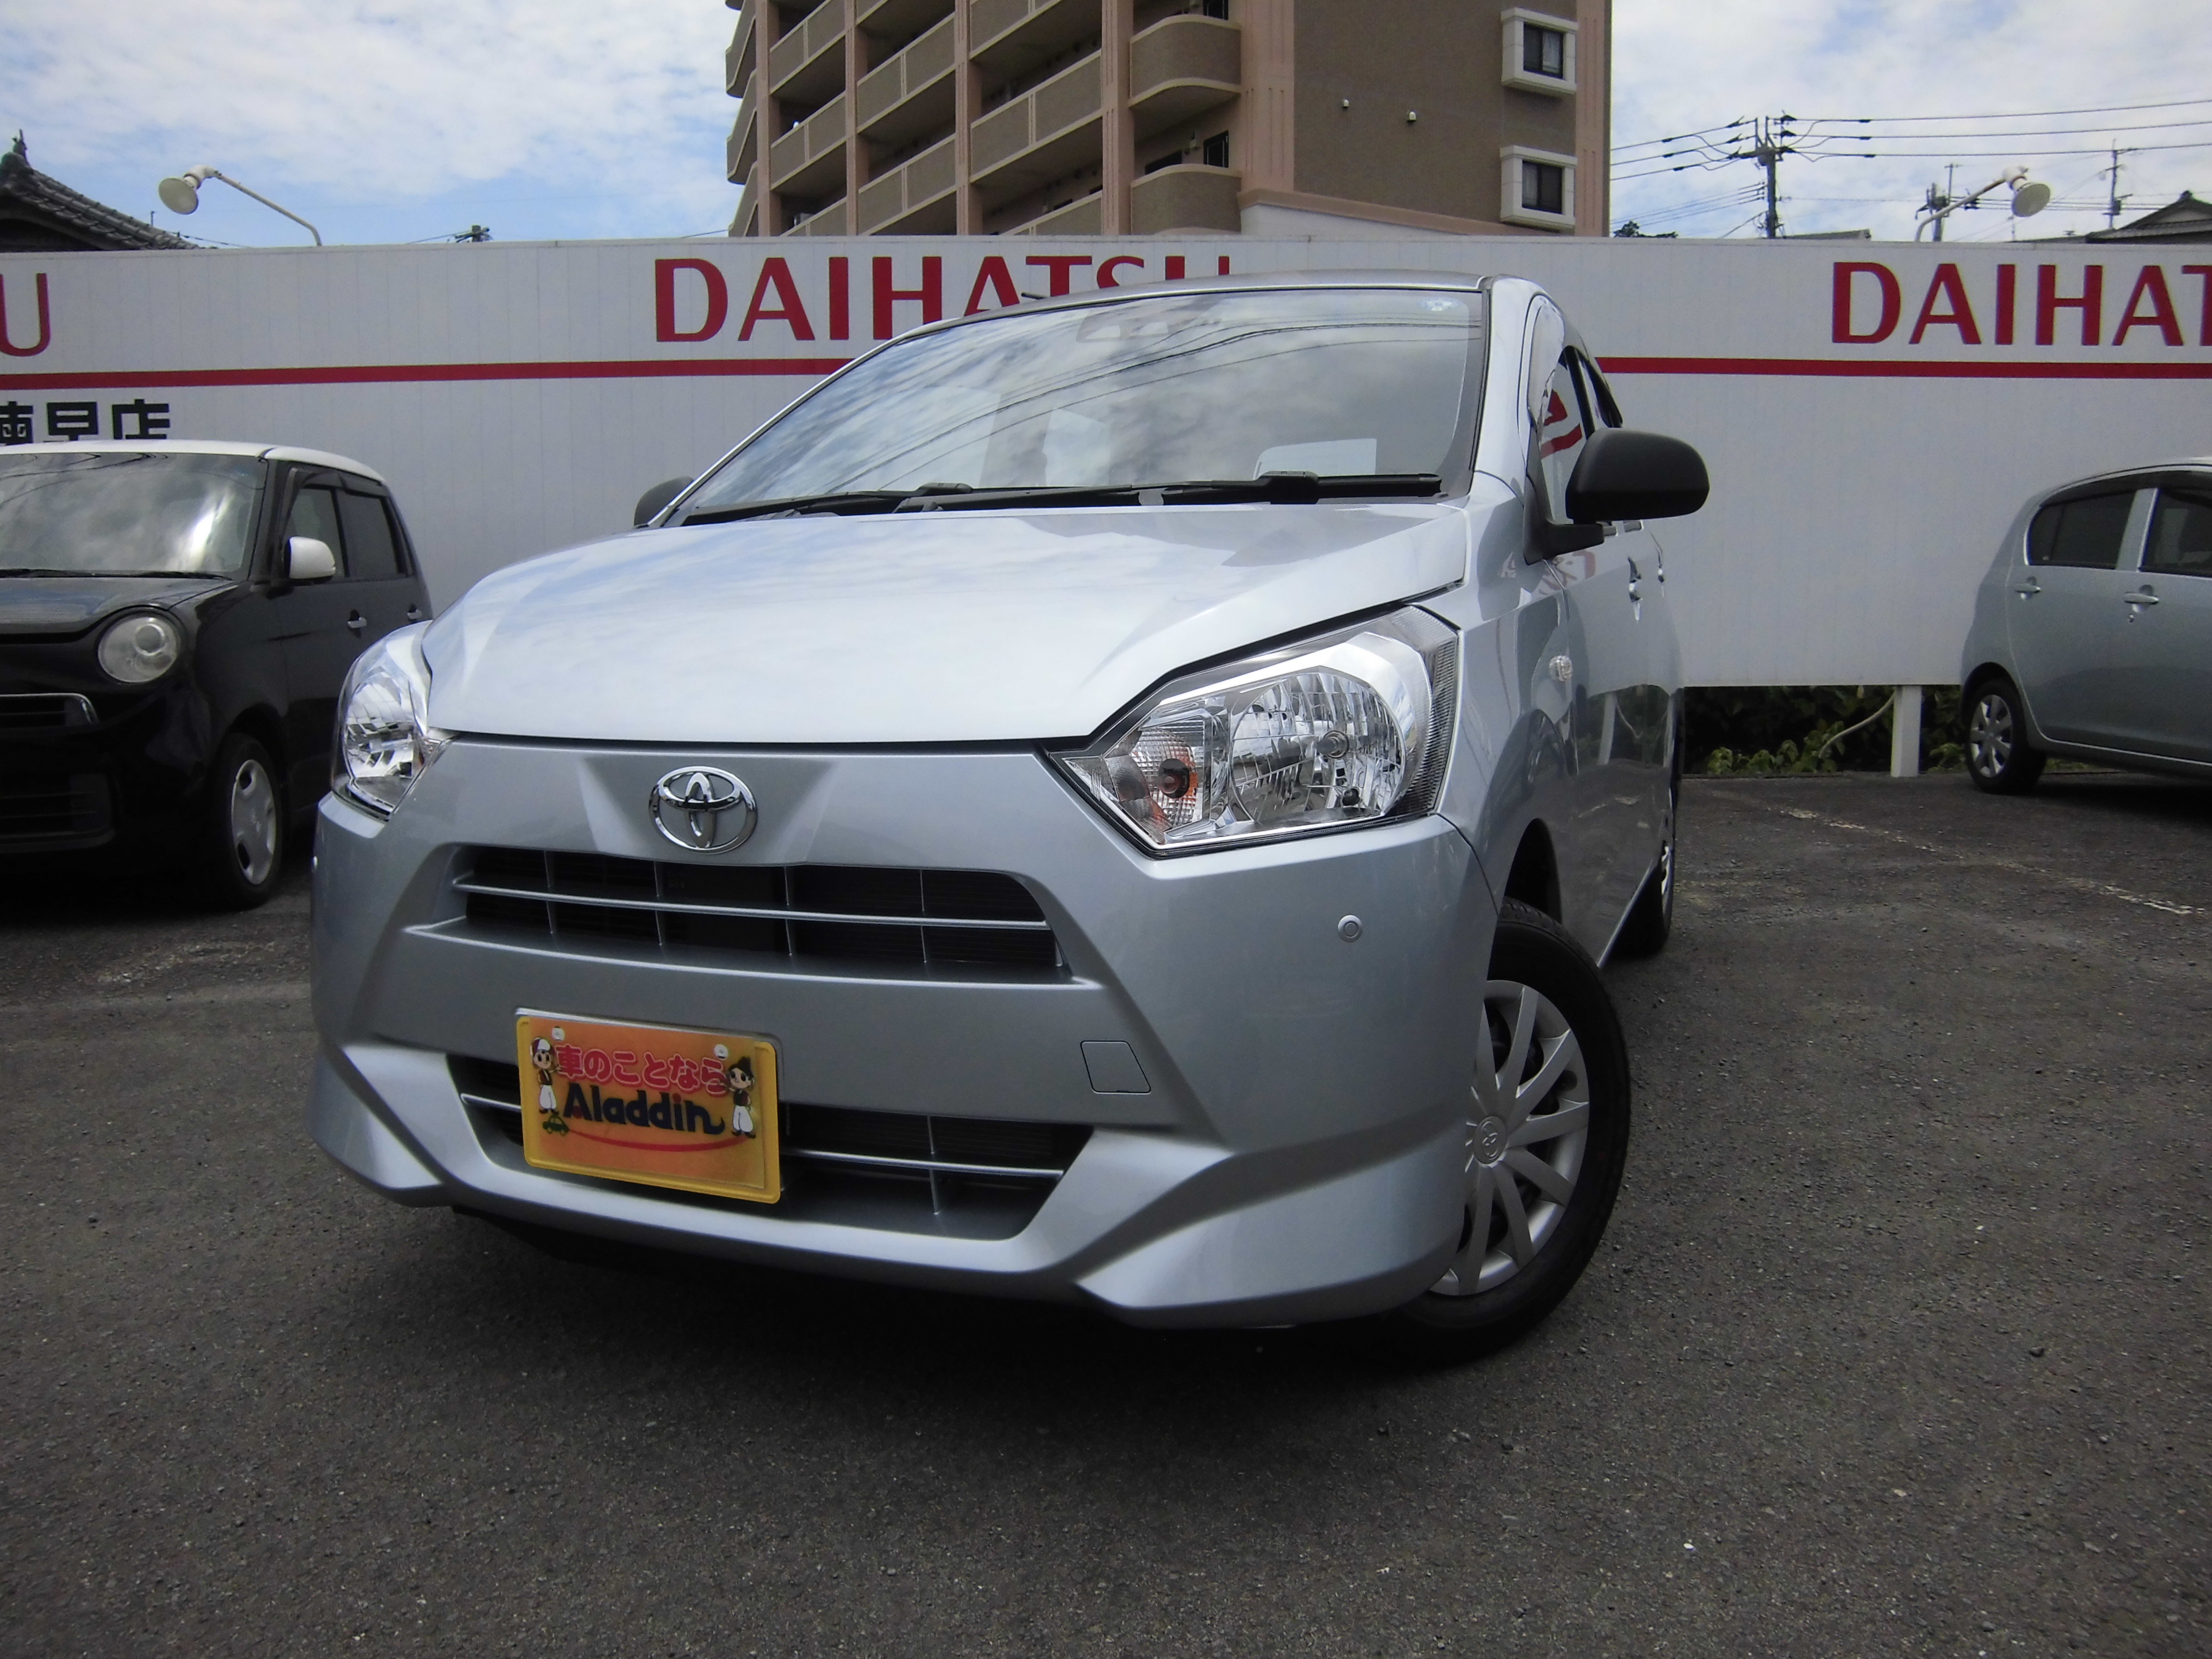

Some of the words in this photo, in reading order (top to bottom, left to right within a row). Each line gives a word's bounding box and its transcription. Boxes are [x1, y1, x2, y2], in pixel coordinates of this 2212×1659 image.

[655, 256, 1230, 342] DAIHAT
[554, 1044, 729, 1097] 車のことなら
[564, 1082, 725, 1135] Aladdin
